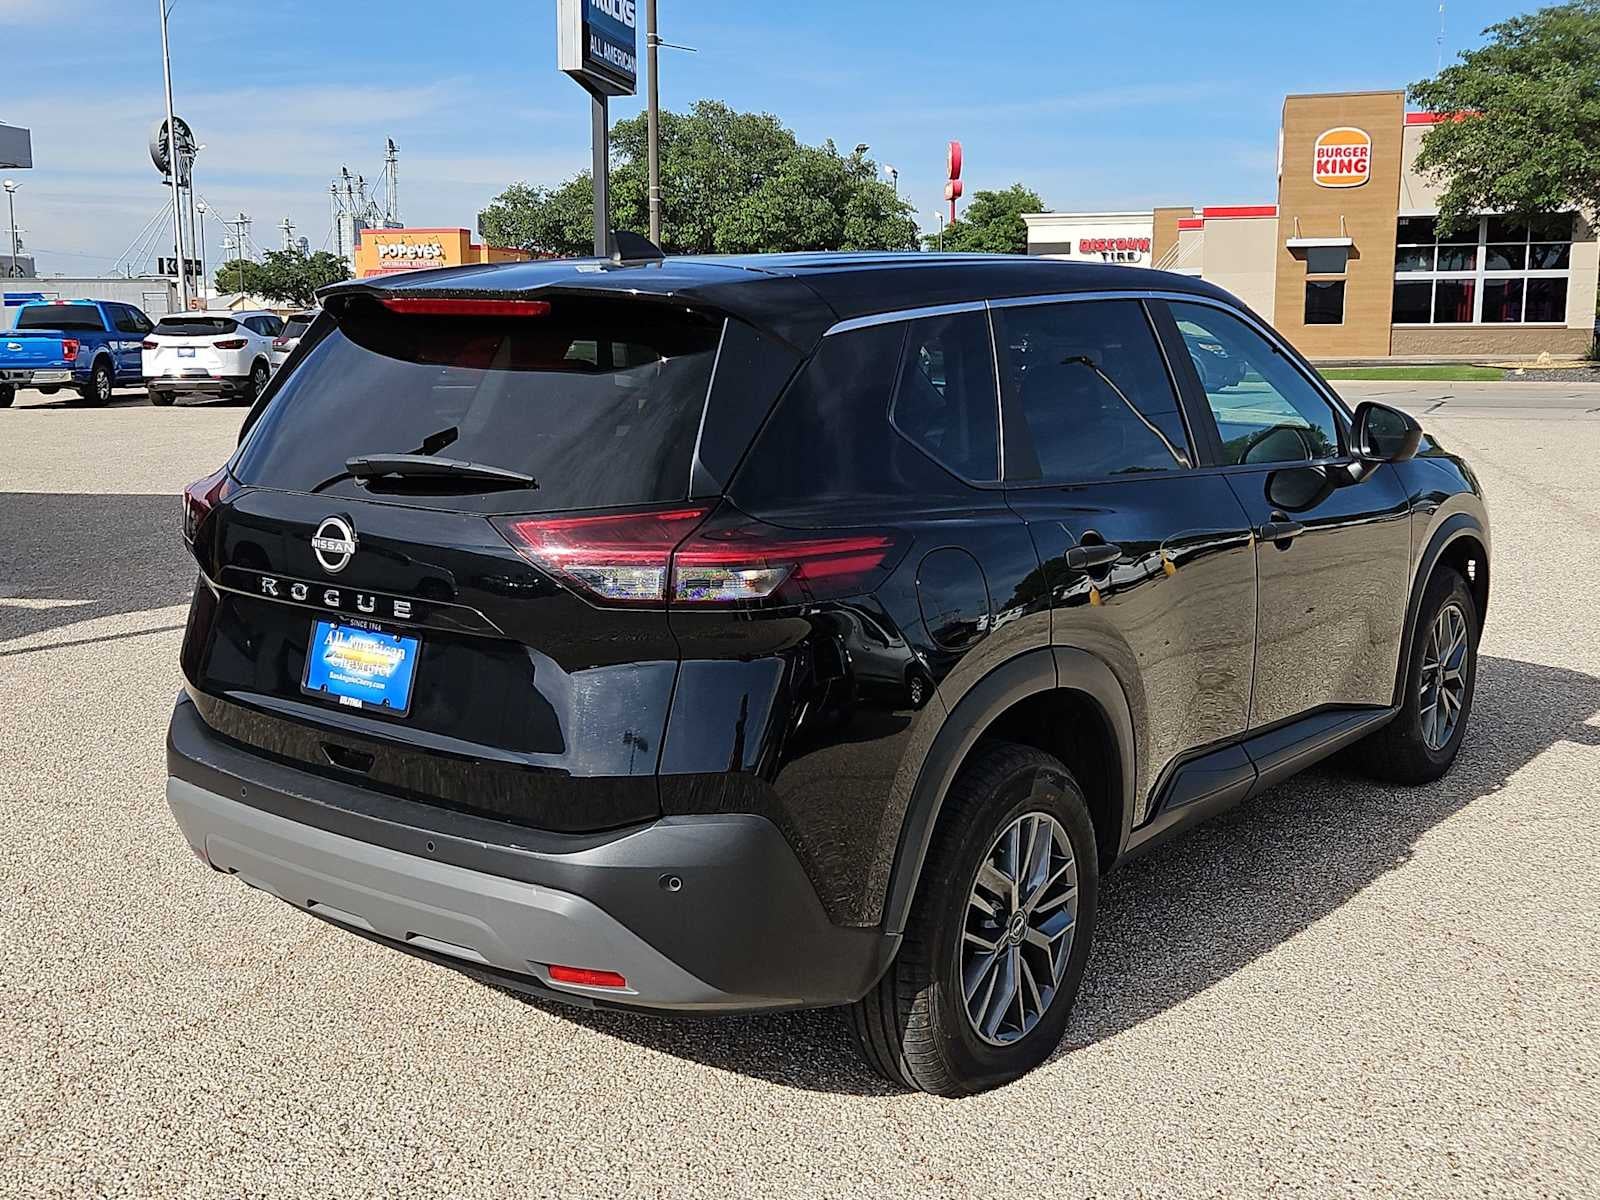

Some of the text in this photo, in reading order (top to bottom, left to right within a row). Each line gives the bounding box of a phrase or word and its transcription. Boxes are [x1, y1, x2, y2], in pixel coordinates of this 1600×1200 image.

[591, 0, 635, 28] UCKS
[590, 33, 636, 74] ALL AMERICAN
[1317, 147, 1368, 158] BURGER
[1316, 159, 1367, 174] KING
[1079, 238, 1151, 254] DISCOUN
[1101, 252, 1136, 262] TIRE
[312, 537, 355, 554] NISSAN
[261, 576, 412, 619] ROGUE
[350, 618, 368, 629] SINCE
[324, 630, 406, 660] All American
